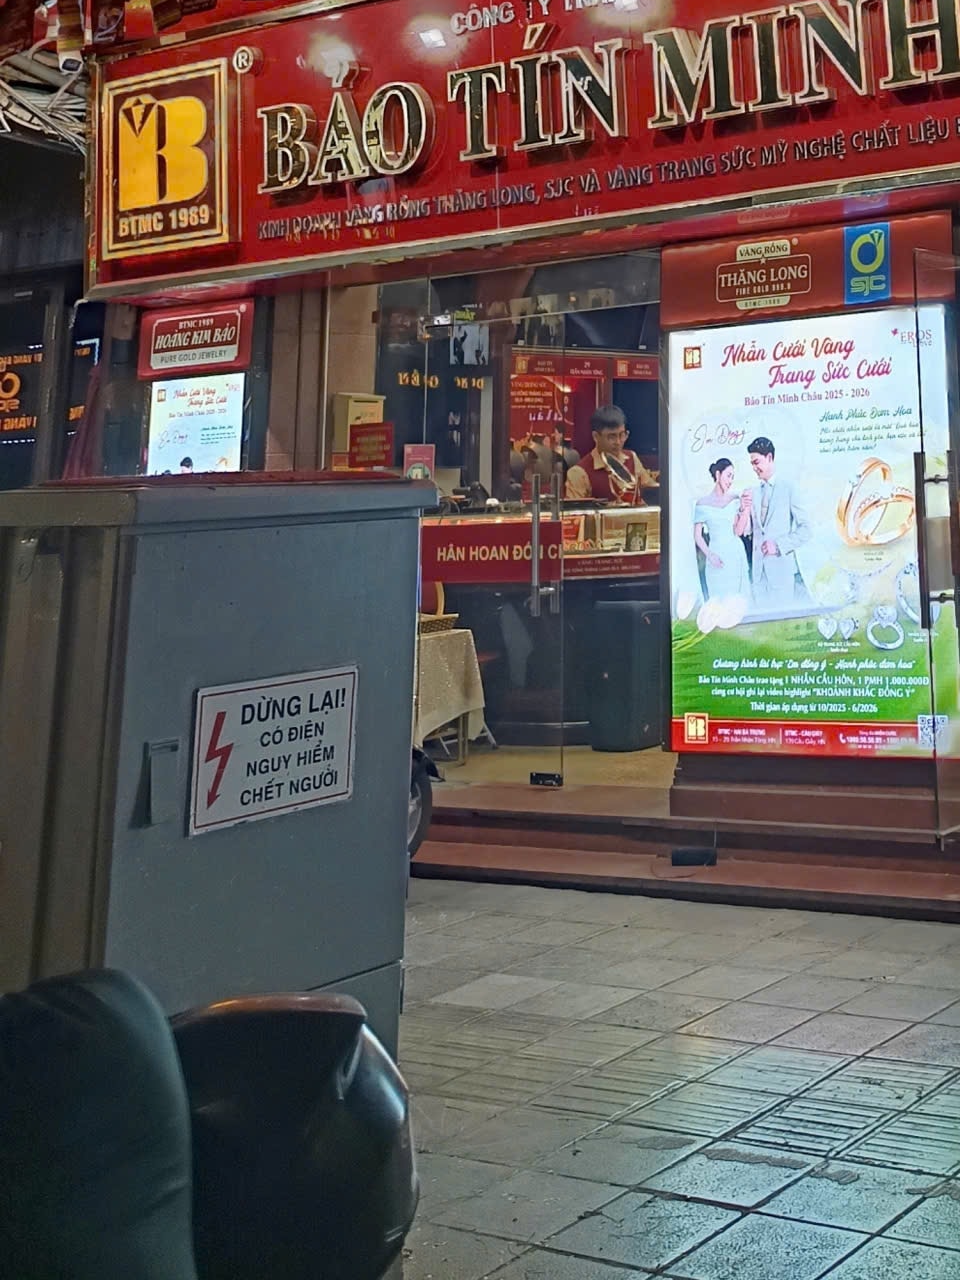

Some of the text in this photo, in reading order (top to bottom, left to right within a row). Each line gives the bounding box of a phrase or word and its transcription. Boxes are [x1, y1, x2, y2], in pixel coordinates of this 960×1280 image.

[450, 2, 516, 36] CÔNG
[257, 58, 430, 194] BẢO
[447, 22, 627, 161] TÍN
[436, 188, 486, 214] THĂNG
[544, 176, 574, 199] SJC
[578, 165, 601, 193] VÀ
[608, 164, 653, 189] VÀNG
[657, 154, 717, 182] TRANG
[721, 143, 756, 171] SỨC
[760, 138, 788, 166] MỸ
[793, 129, 847, 161] NGHỆ
[851, 119, 901, 151] CHẤT
[906, 115, 949, 145] LIỆU
[119, 204, 209, 236] BTMC 1989
[739, 245, 763, 258] VÀNG
[719, 264, 809, 288] THĂNG LONG
[154, 322, 237, 351] HOÀNG KIM BẢO
[160, 349, 228, 365] PURE GOLD JEWELRY
[721, 337, 856, 368] Nhẫn Cưới Vàng
[767, 357, 893, 389] Trang Sức Cưới
[776, 393, 800, 405] Minh
[801, 390, 823, 403] Châu
[824, 389, 844, 401] 2025
[849, 387, 871, 399] 2026
[436, 542, 465, 561] HÂN
[469, 544, 510, 561] HOAN
[241, 687, 346, 725] DỪNG LẠI!
[260, 720, 325, 747] CÓ ĐIỆN
[246, 740, 335, 777] NGUY HIỂM
[240, 764, 338, 806] CHẾT NGƯỜI
